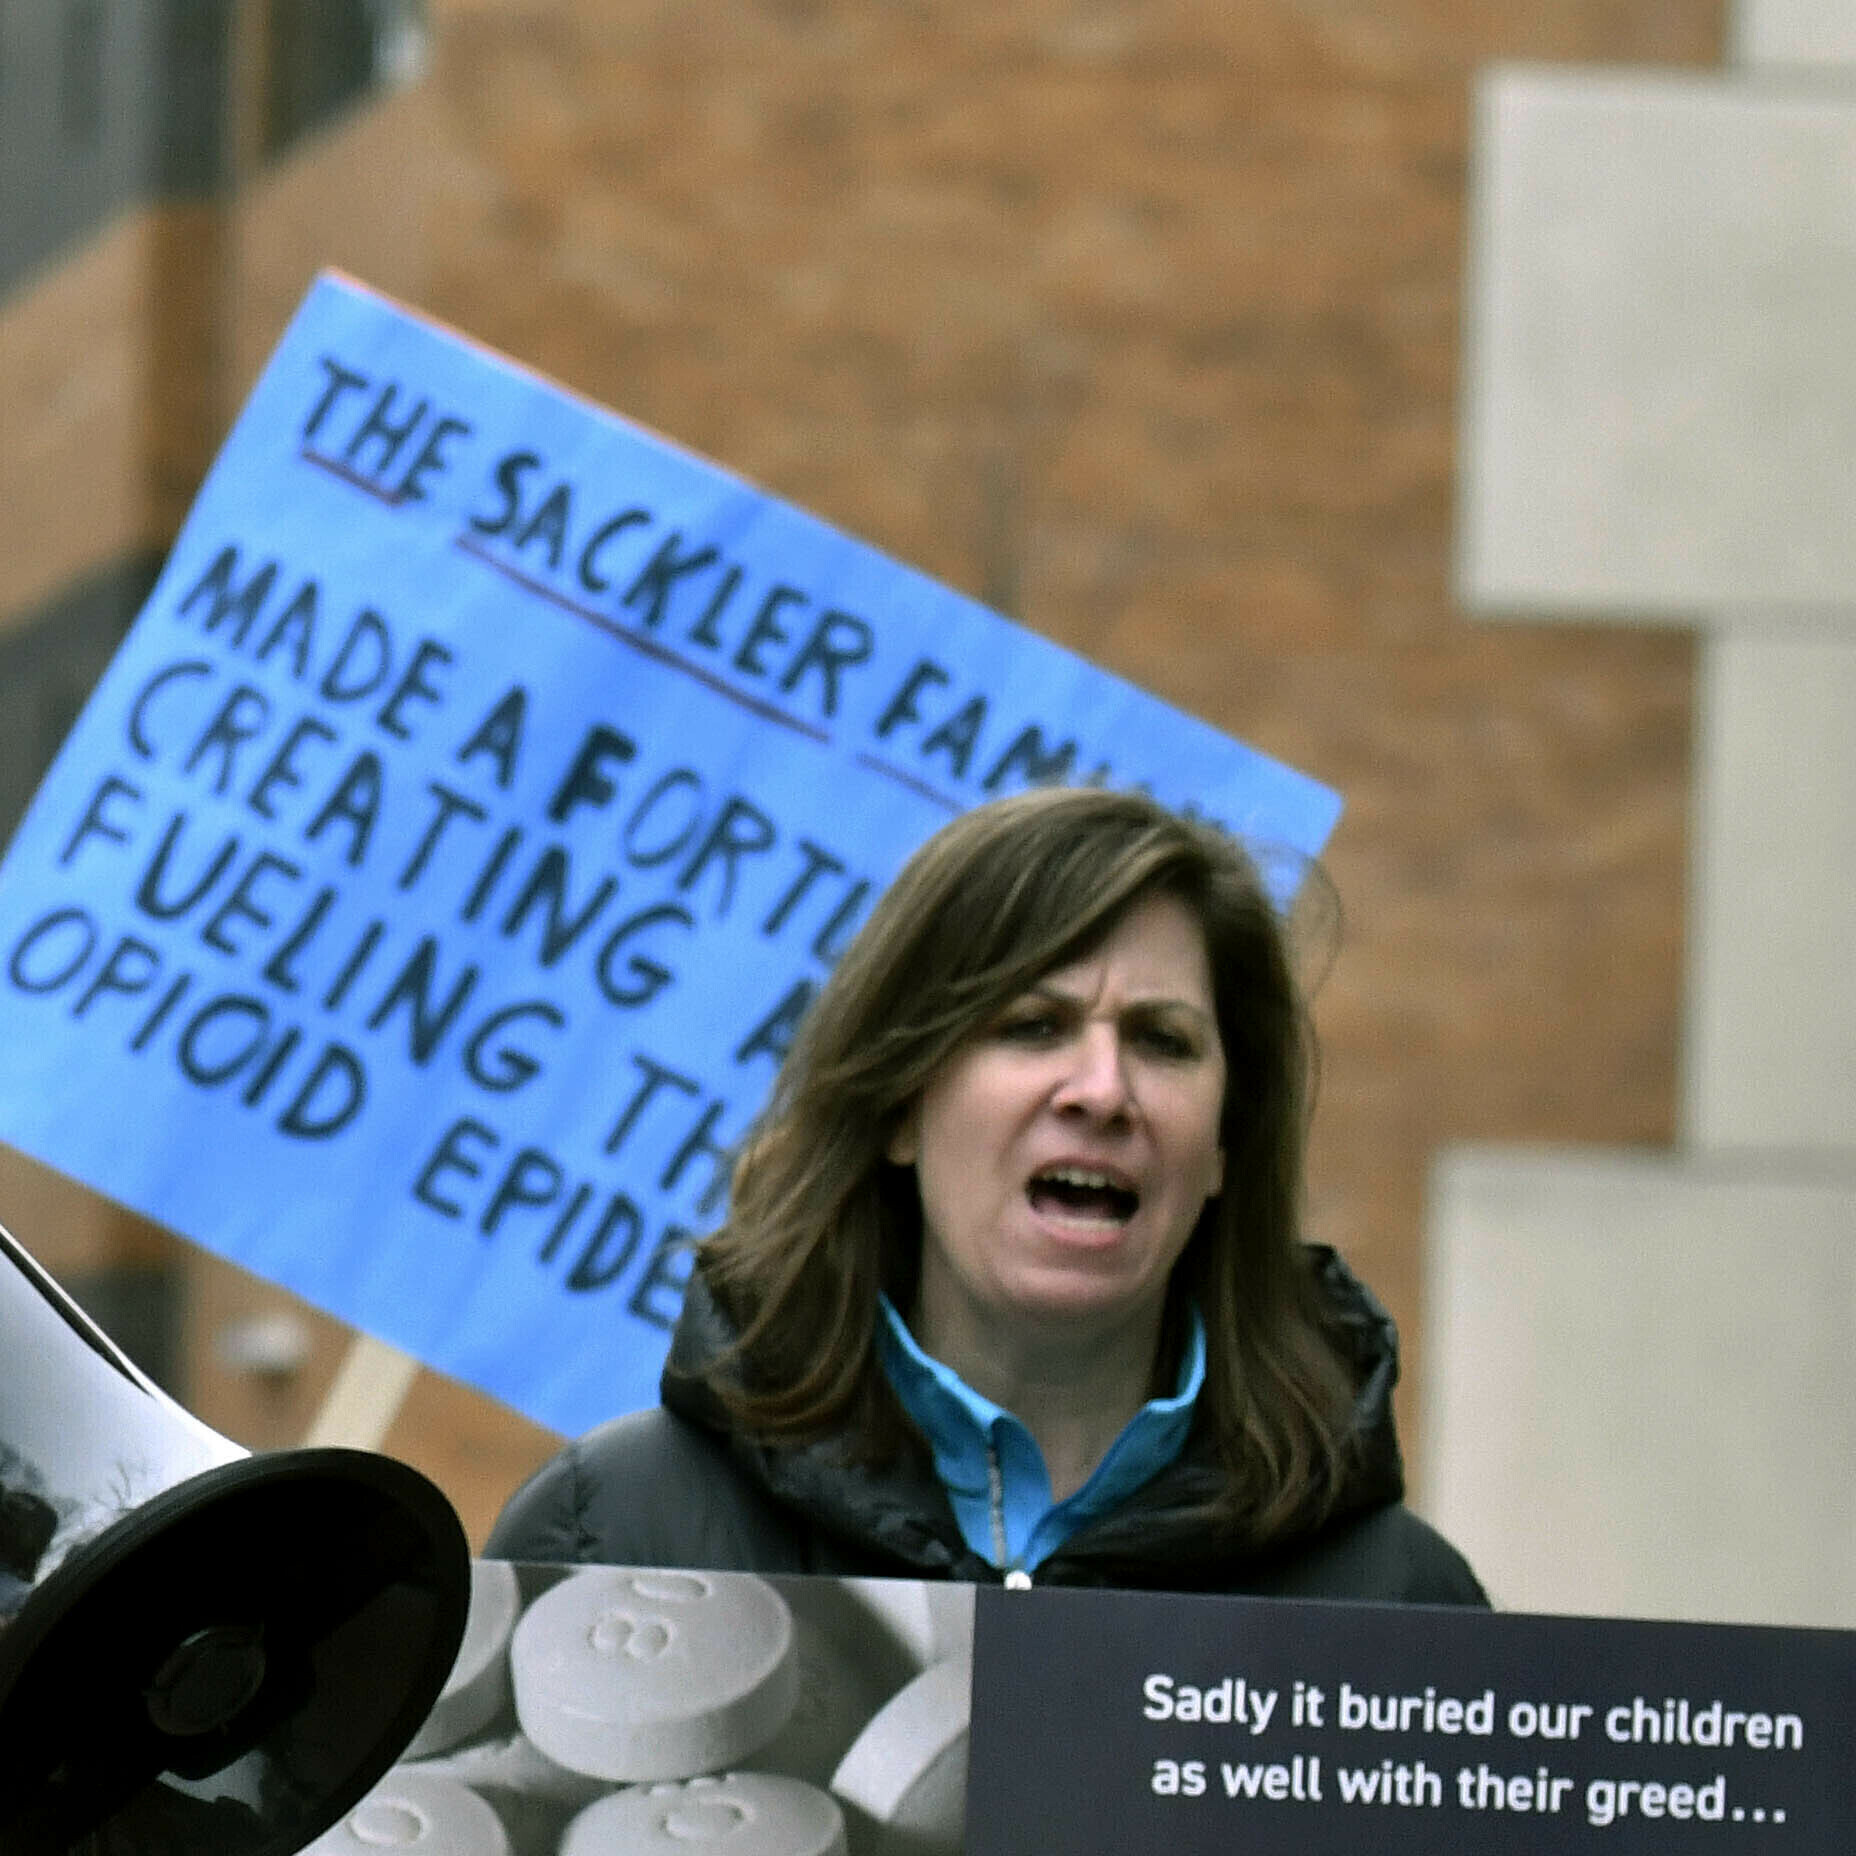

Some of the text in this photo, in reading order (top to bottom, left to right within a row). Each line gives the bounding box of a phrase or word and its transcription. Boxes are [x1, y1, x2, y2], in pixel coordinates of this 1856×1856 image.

[176, 546, 455, 741] MADE
[458, 683, 528, 791] A
[298, 357, 471, 502] THE
[471, 451, 873, 718] SACKLER
[58, 772, 728, 1218] FUELING TH
[127, 660, 693, 1008] CREATING
[8, 906, 691, 1330] OPIOID EPIDE
[1143, 1674, 1803, 1750] Sadly it buried our children
[1151, 1760, 1207, 1796] as
[1221, 1756, 1322, 1801] well
[1337, 1760, 1442, 1807] with
[1457, 1764, 1574, 1812] their
